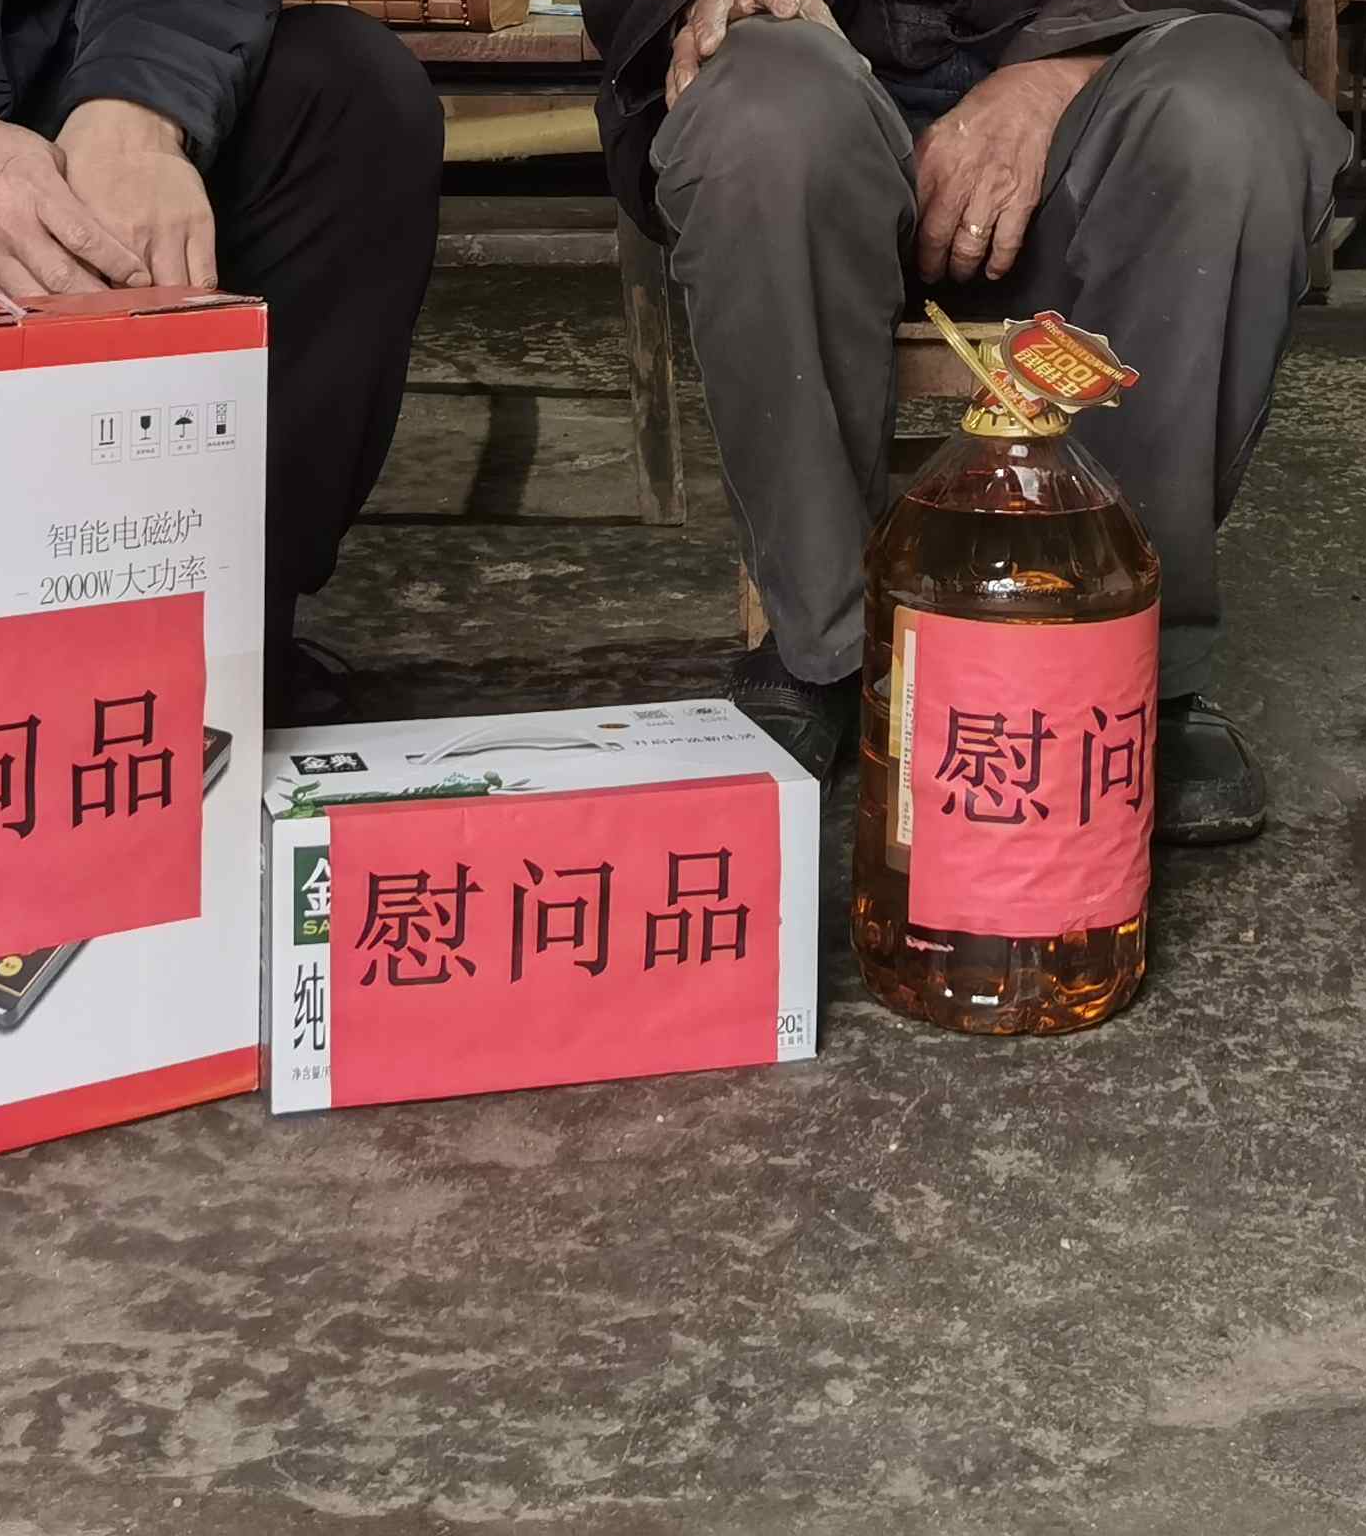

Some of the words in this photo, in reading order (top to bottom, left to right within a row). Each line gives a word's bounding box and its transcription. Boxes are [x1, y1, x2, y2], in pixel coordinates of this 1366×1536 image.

[46, 508, 203, 559] 智能电磁炉
[40, 555, 208, 605] 2000W大功率
[934, 701, 1147, 827] 慰问
[353, 846, 750, 986] 慰问品
